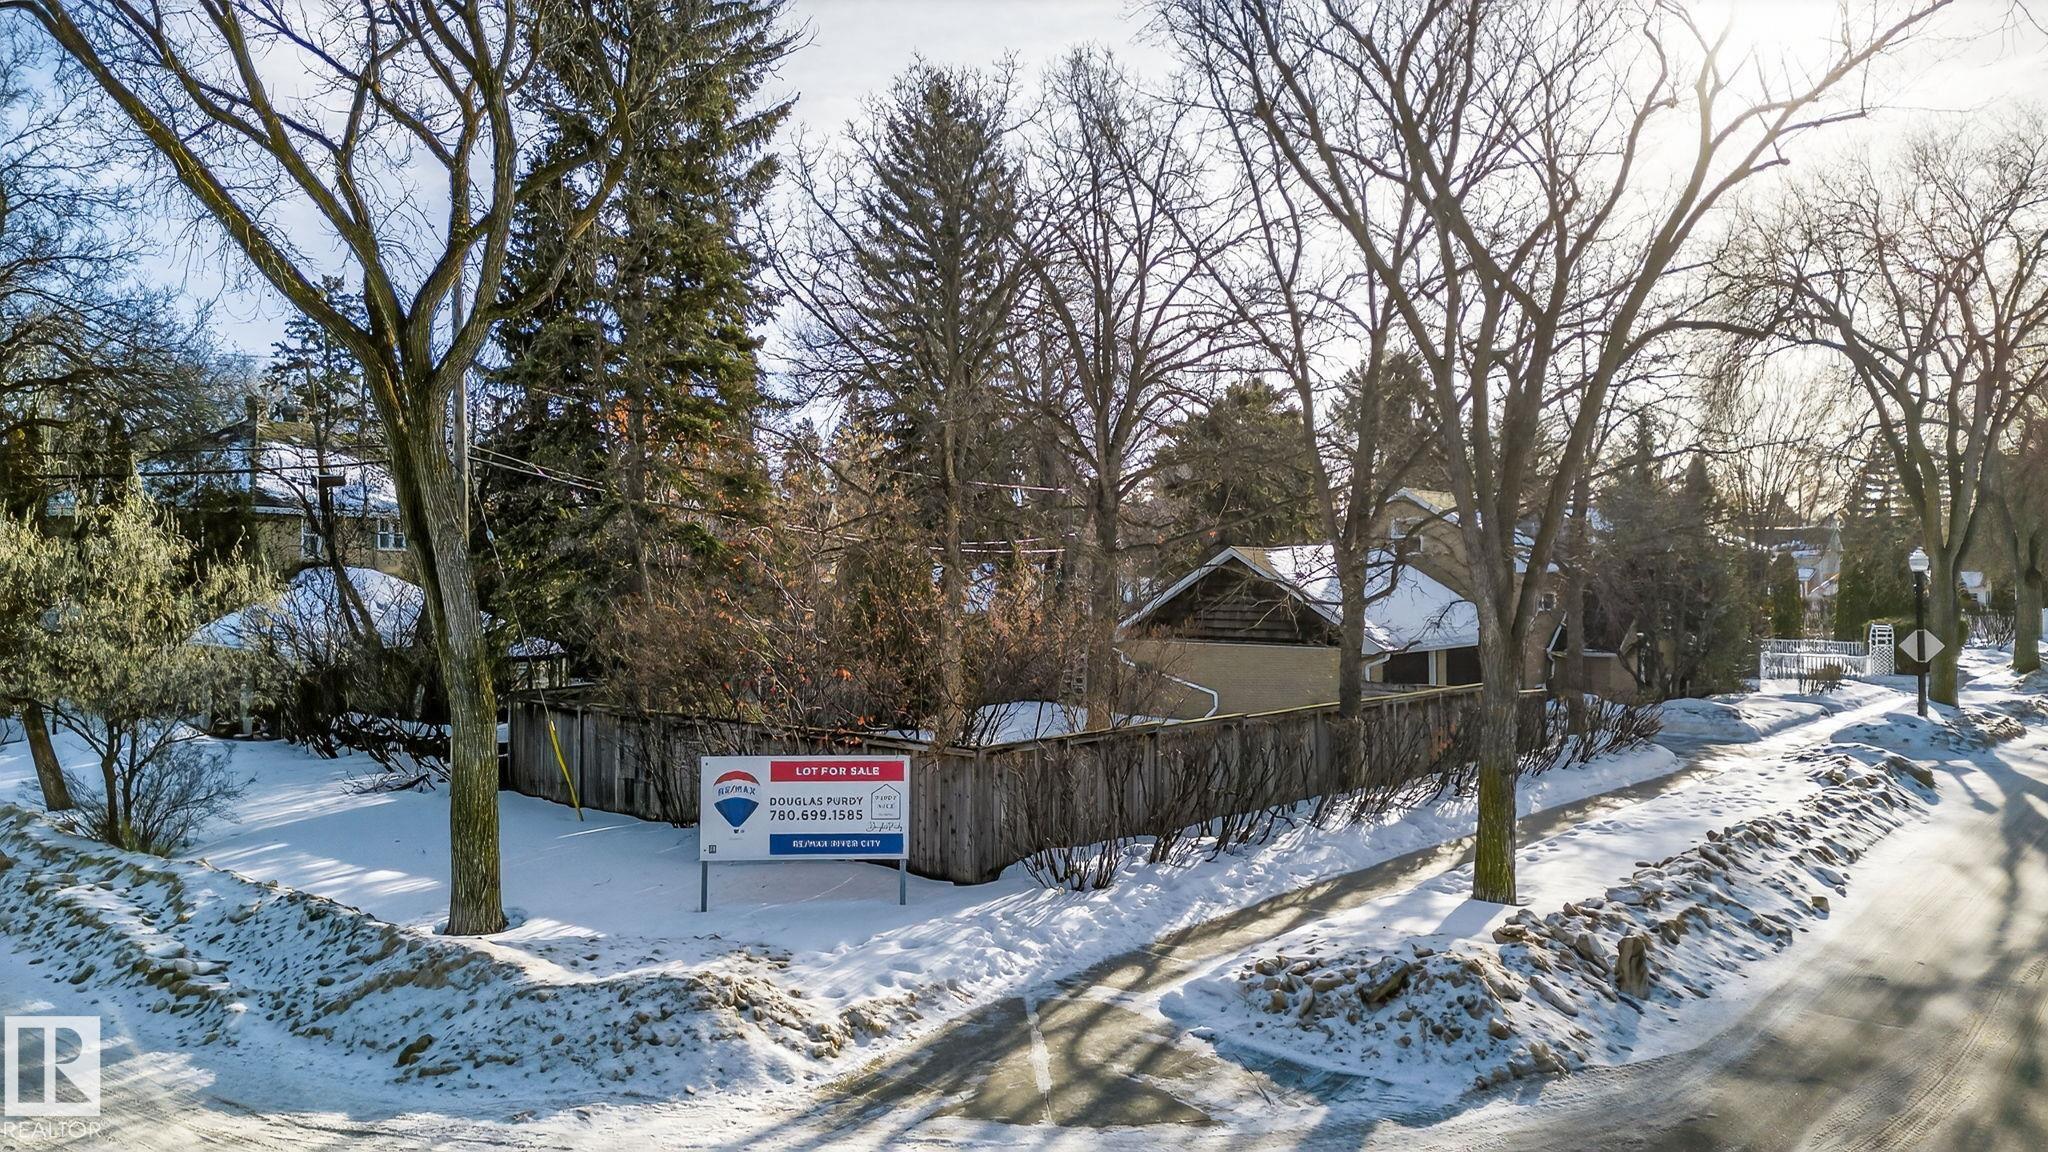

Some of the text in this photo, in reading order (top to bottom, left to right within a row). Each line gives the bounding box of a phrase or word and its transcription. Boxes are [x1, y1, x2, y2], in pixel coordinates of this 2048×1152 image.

[796, 766, 880, 776] LOT FOR SALE
[717, 784, 756, 797] RE/MAX
[769, 796, 864, 806] DOUGLAS PURDY
[769, 810, 864, 821] 780.699.1585
[861, 839, 881, 848] CITY
